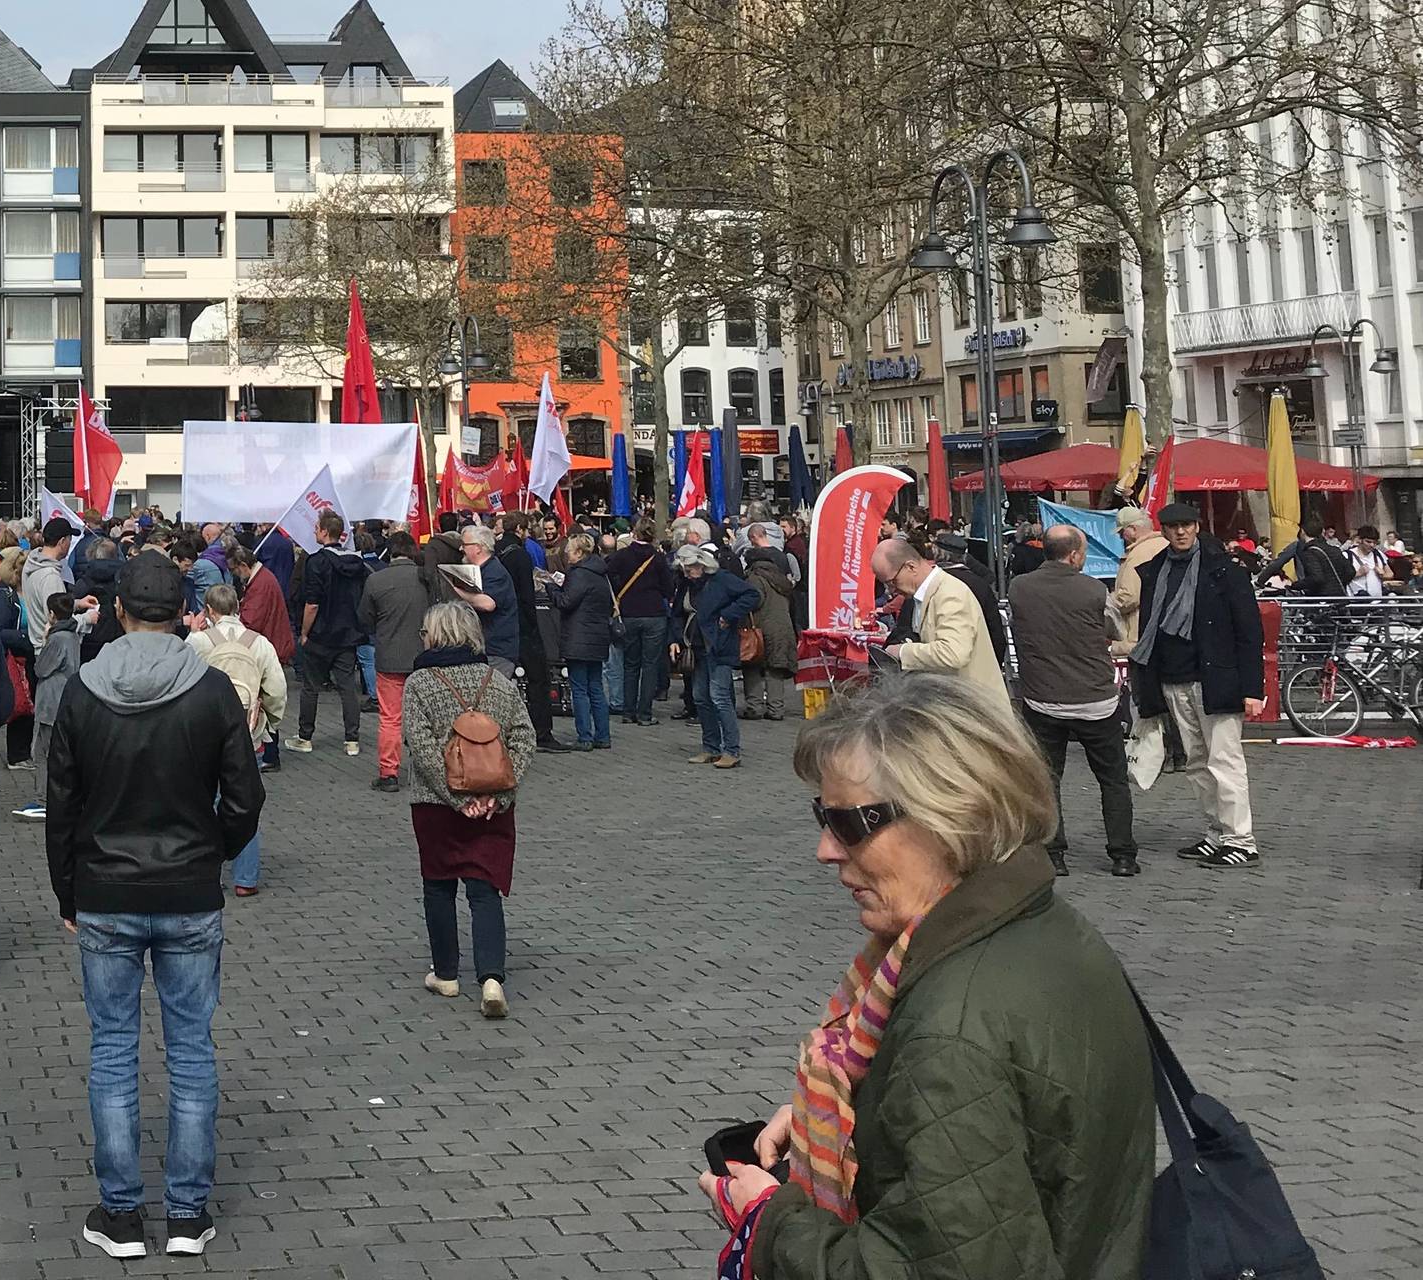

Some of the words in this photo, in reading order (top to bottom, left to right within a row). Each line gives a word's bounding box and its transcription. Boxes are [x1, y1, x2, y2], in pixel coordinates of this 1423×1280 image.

[1035, 405, 1055, 416] sky
[842, 487, 861, 571] Sozialistische
[850, 510, 867, 577] Alternative
[839, 571, 859, 629] SAV
